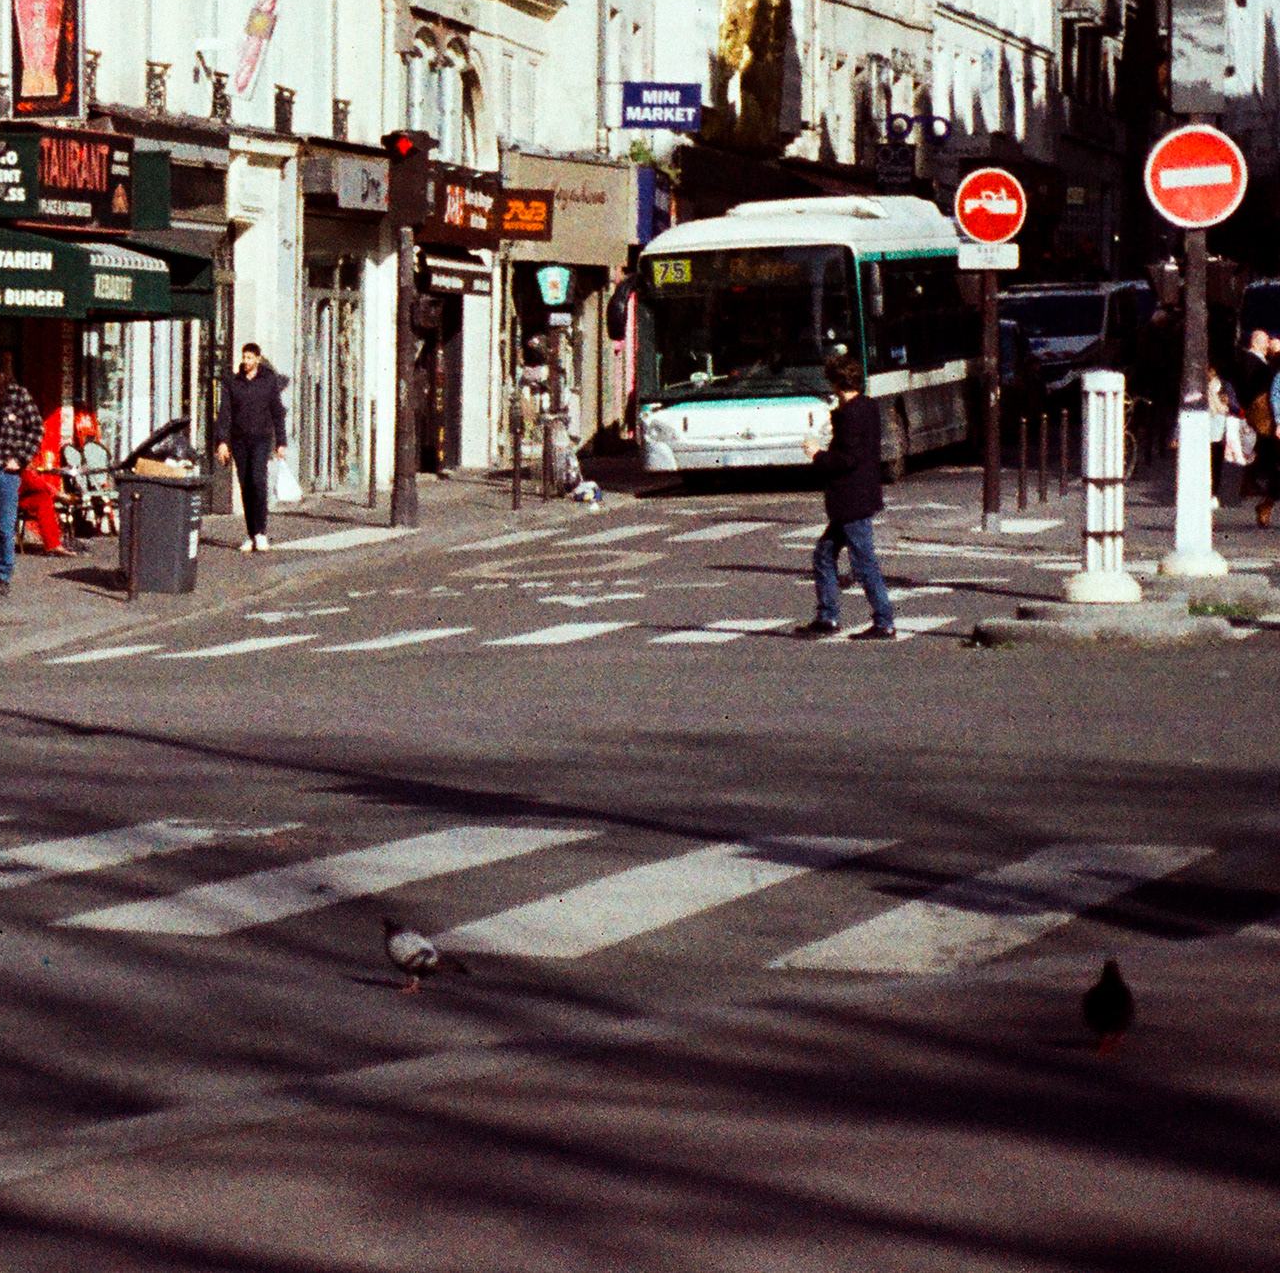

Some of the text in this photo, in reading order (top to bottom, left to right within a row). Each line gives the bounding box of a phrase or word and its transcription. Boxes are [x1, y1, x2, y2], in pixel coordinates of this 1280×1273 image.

[642, 90, 682, 104] MINI
[625, 106, 697, 122] MARKET
[659, 260, 686, 282] 75
[4, 288, 65, 307] BURGER
